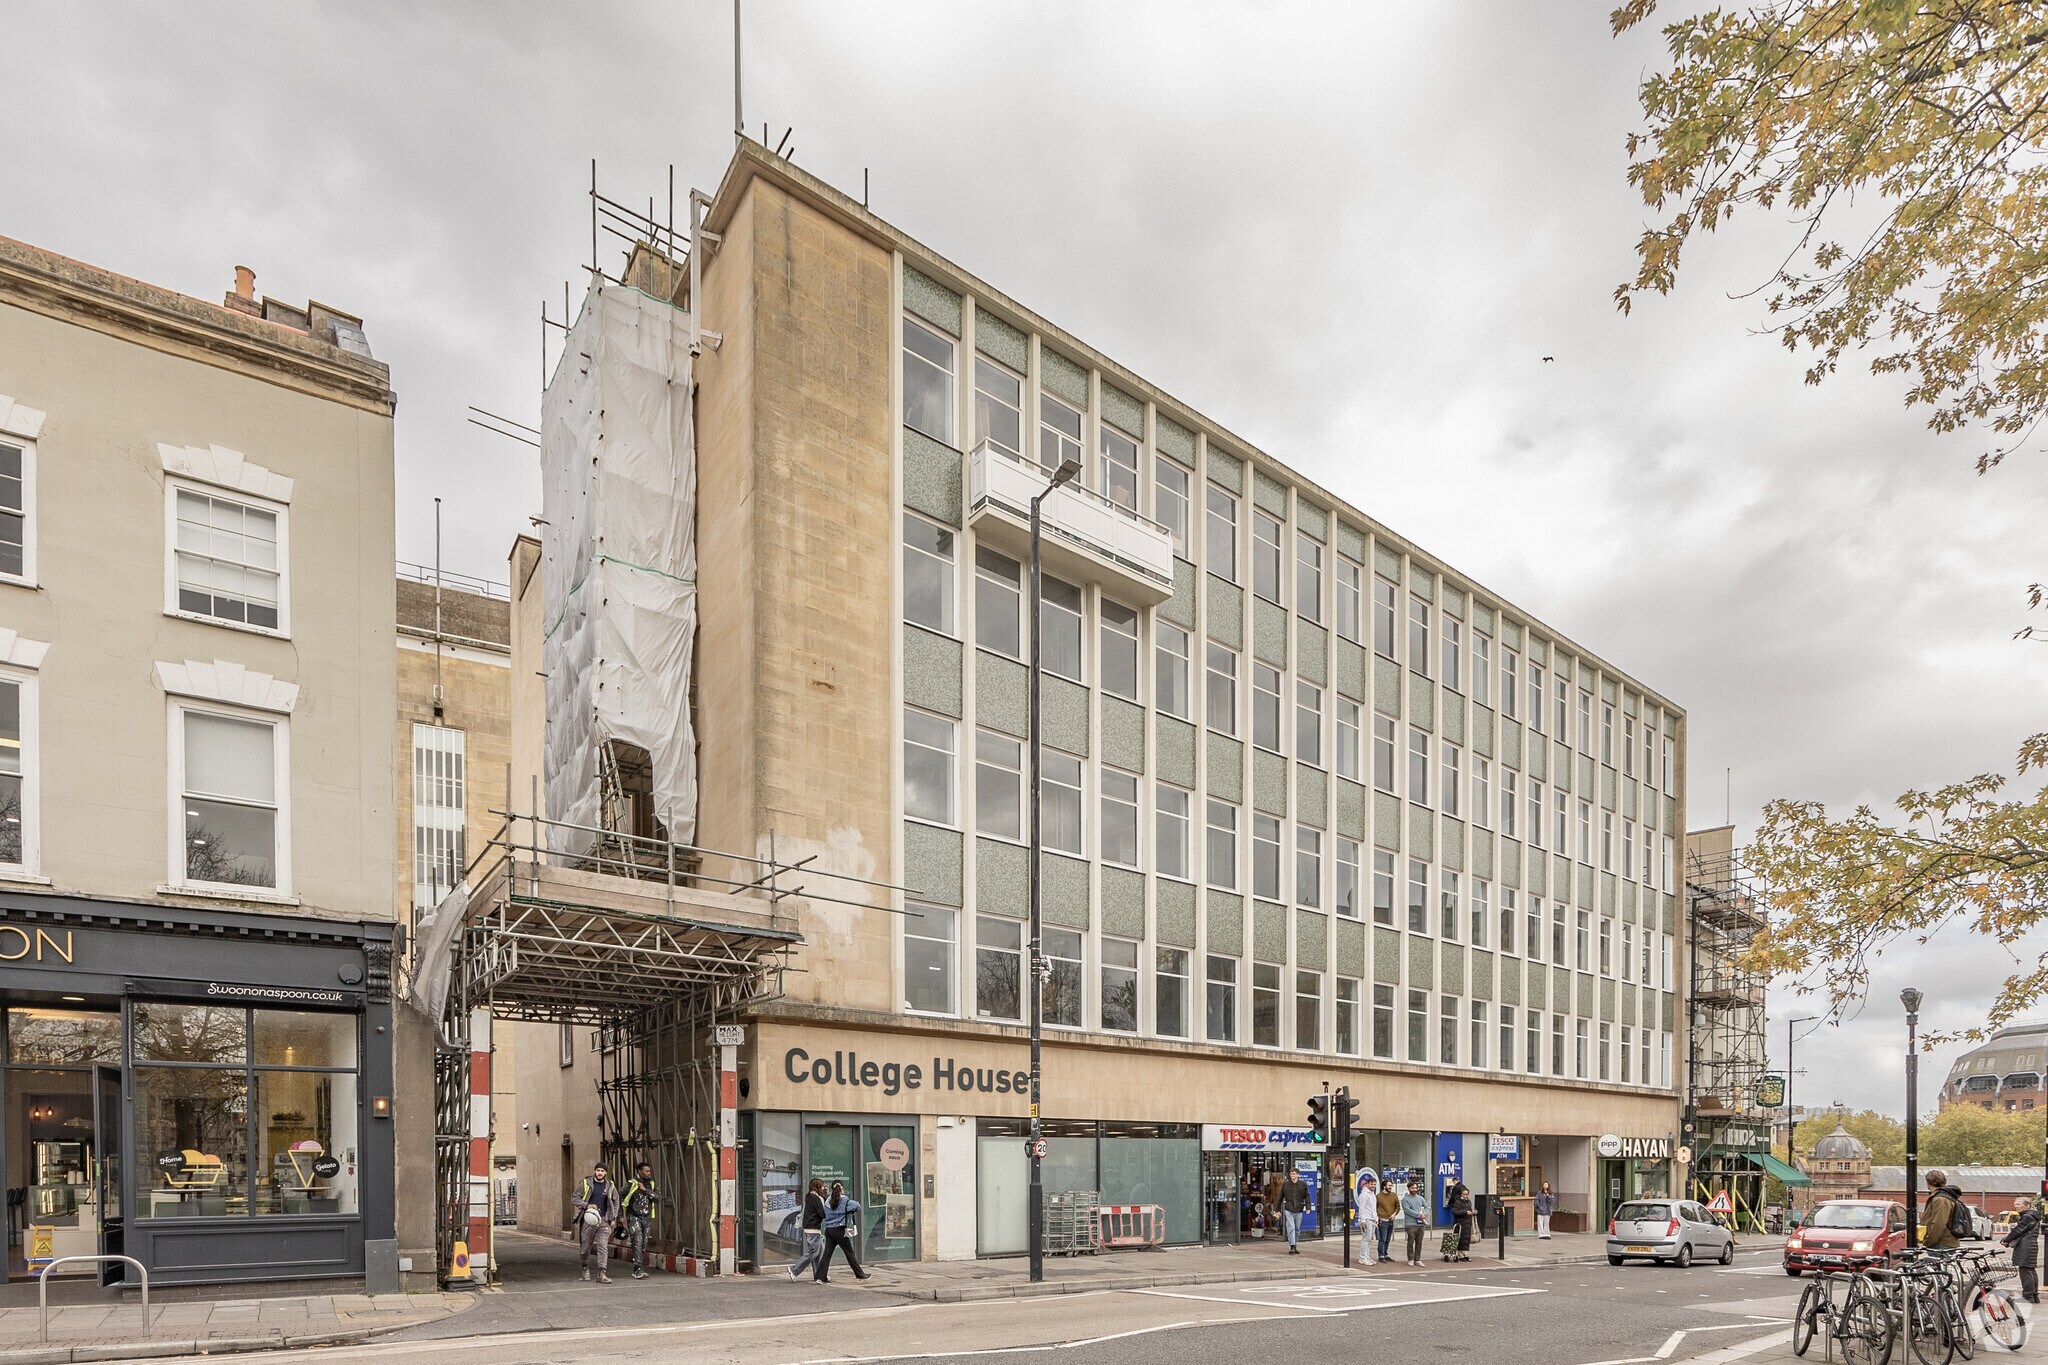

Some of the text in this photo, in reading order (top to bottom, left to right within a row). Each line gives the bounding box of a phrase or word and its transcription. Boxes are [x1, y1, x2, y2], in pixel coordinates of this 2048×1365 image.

[207, 982, 342, 1001] Swoononaspoon.co.uk
[785, 1048, 1029, 1096] College House
[1220, 1128, 1266, 1142] TESCO
[1037, 1145, 1045, 1153] 20
[1601, 1140, 1618, 1148] pipp
[1615, 1138, 1668, 1158] HAYAN
[1438, 1163, 1455, 1174] ATM
